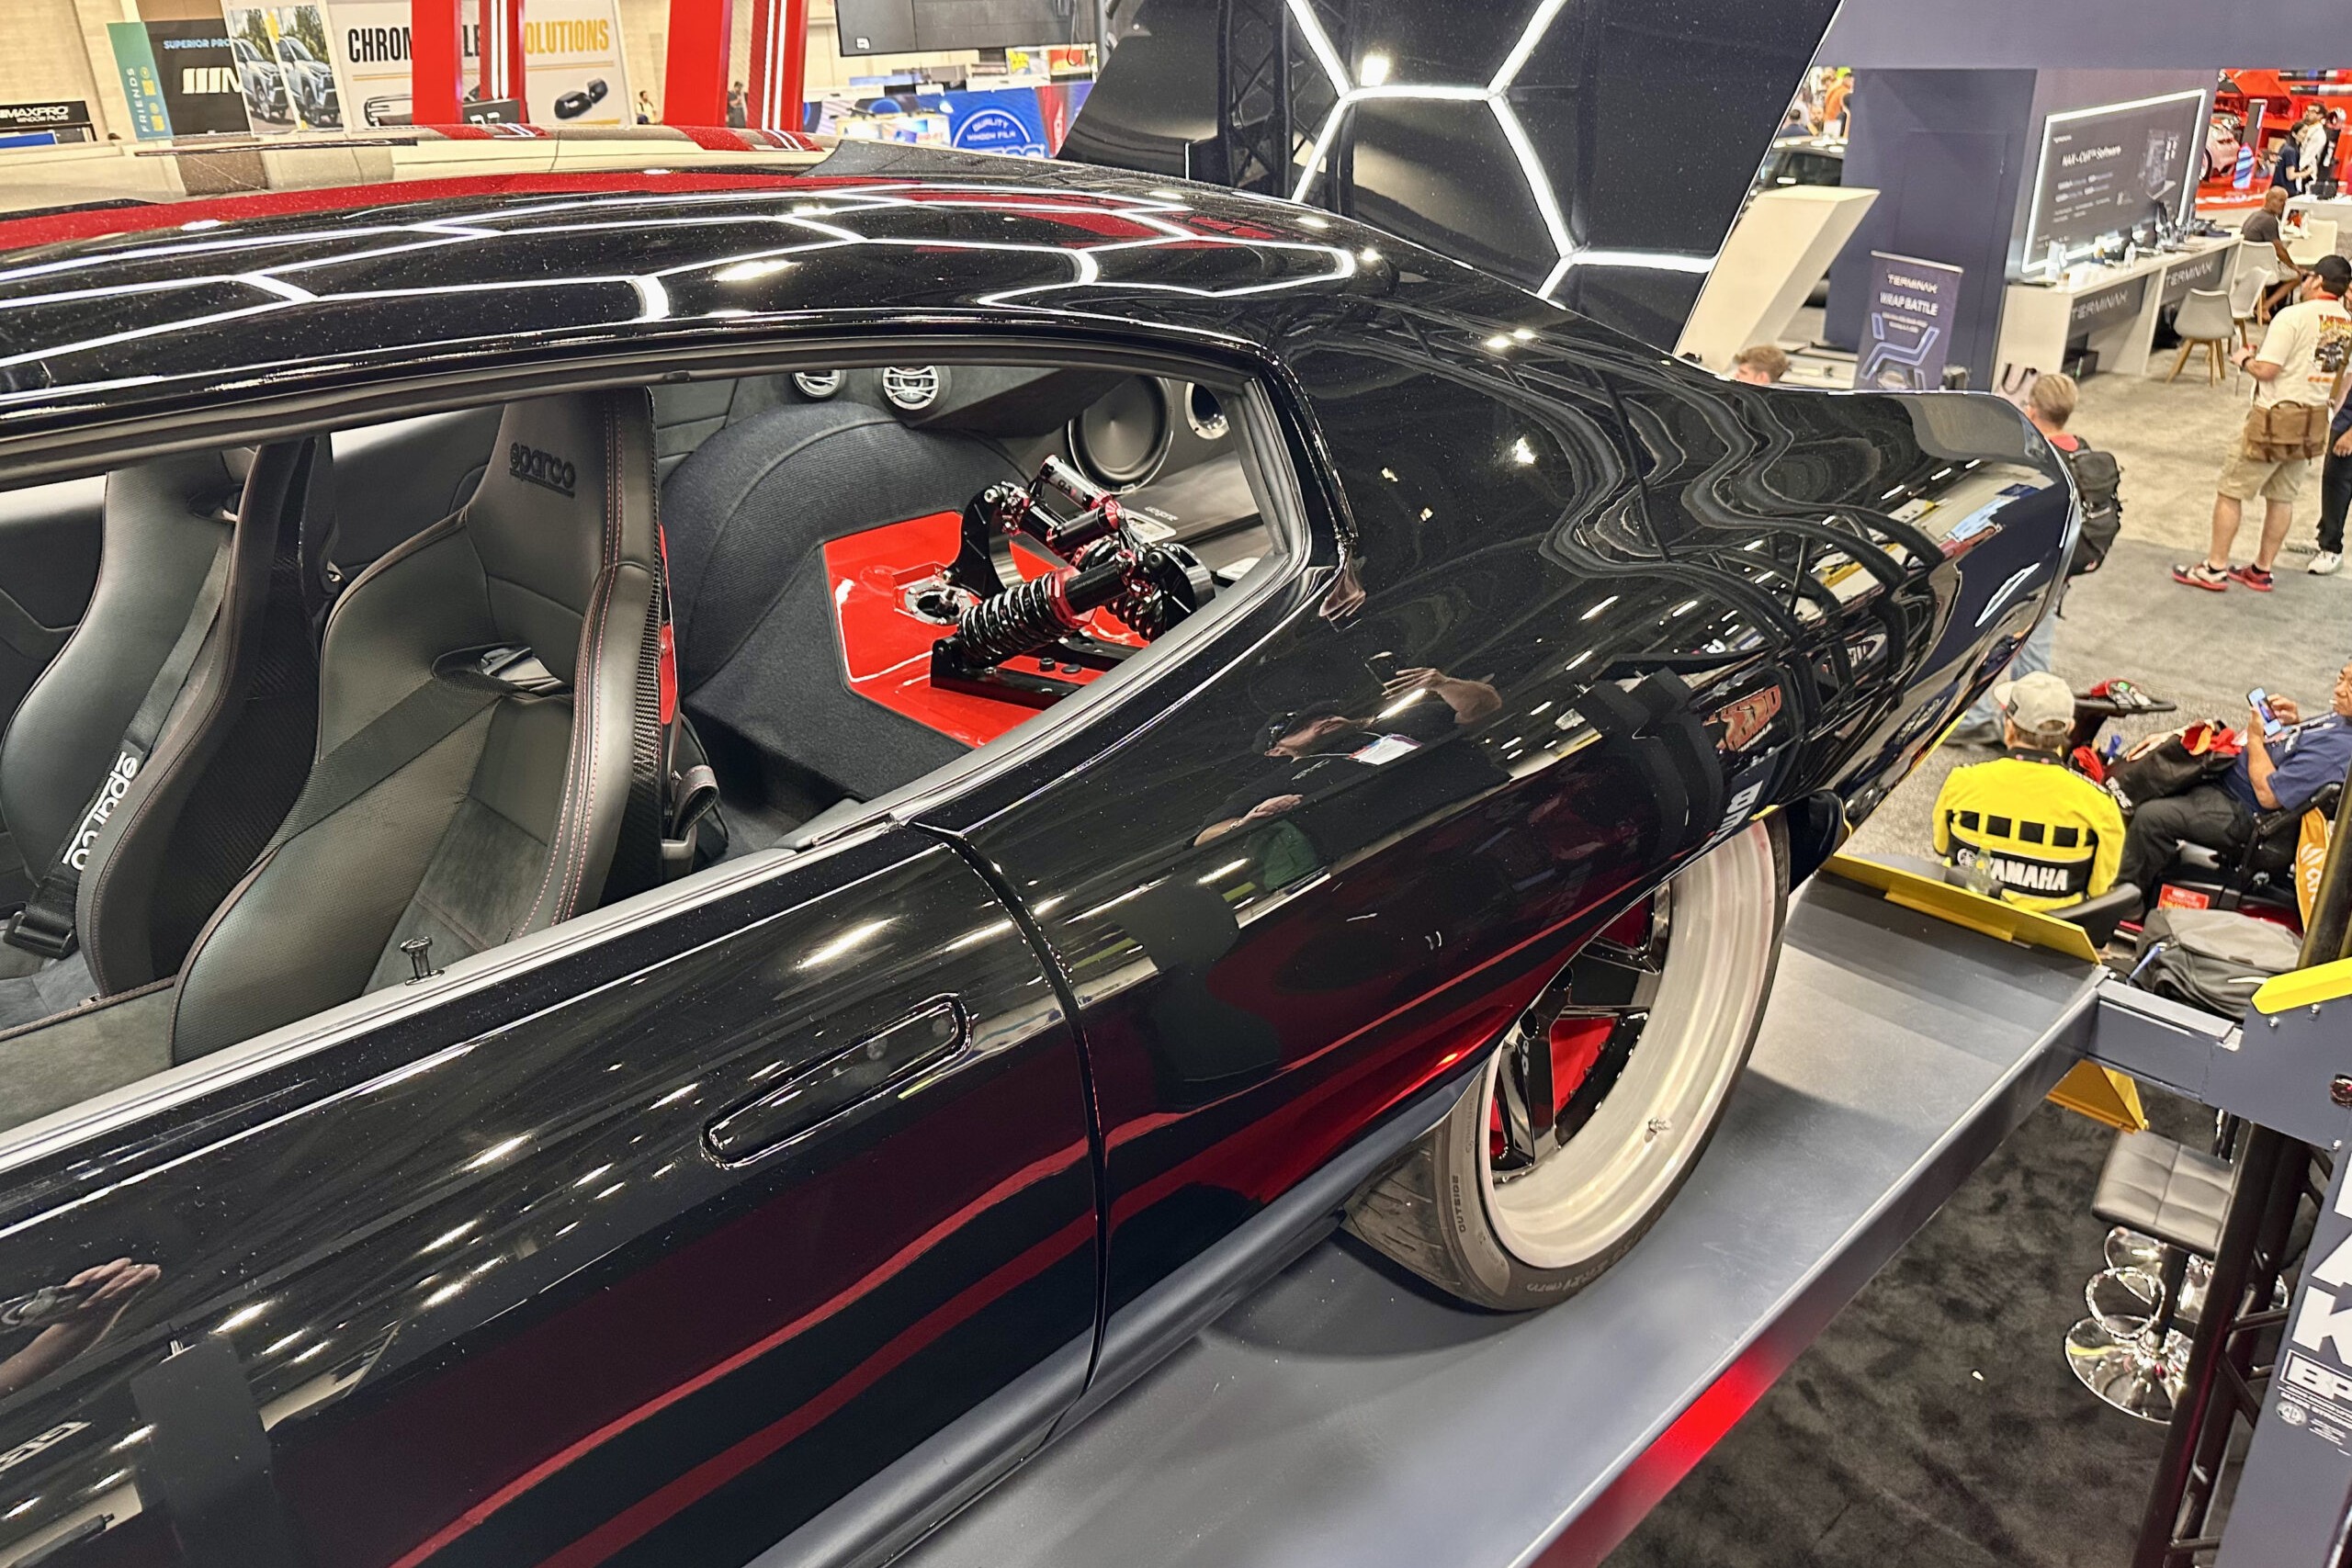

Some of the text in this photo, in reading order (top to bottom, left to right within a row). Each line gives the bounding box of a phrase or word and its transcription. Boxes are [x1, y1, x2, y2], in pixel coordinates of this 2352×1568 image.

[164, 38, 231, 49] SUPERIOR PRO
[524, 18, 609, 54] OLUTIONS
[126, 67, 150, 132] FRIENDS
[6, 106, 69, 118] MAXPRO
[967, 131, 997, 141] WINDOW
[971, 118, 1010, 132] QUALITY
[1887, 273, 1939, 294] TERMINAX
[1879, 291, 1939, 317] WRAP BATTLE
[510, 442, 576, 489] sparco
[1452, 1175, 1466, 1233] OUTSIDE
